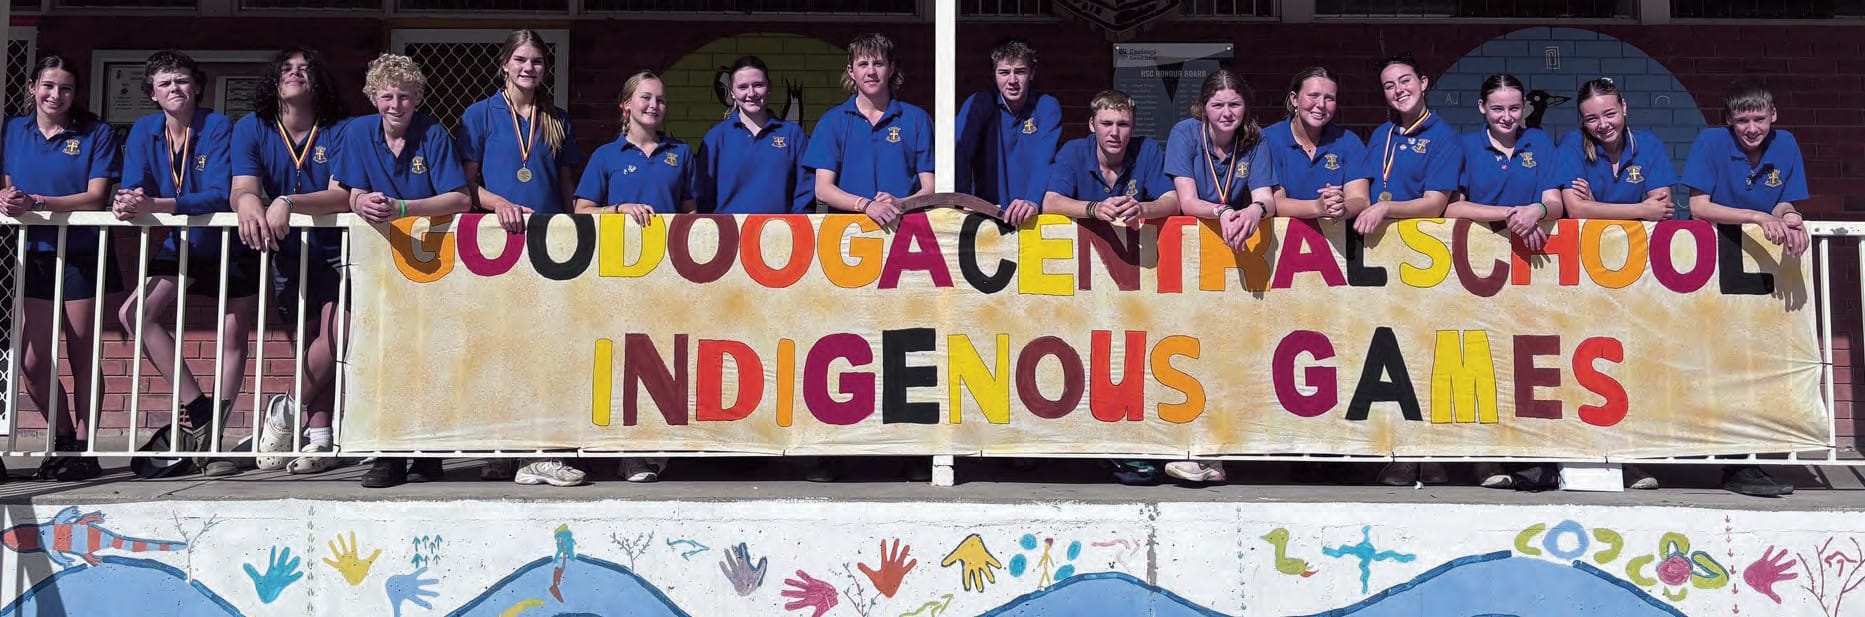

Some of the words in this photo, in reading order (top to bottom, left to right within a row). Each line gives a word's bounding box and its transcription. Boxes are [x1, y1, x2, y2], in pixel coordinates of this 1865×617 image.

[1184, 70, 1207, 78] BOARD
[391, 213, 954, 290] GOODOOGA
[958, 215, 1388, 297] CENTRAL
[1397, 218, 1775, 298] SCHOOL
[592, 327, 1207, 428] INDIGENOUS
[1272, 326, 1630, 427] GAMES
